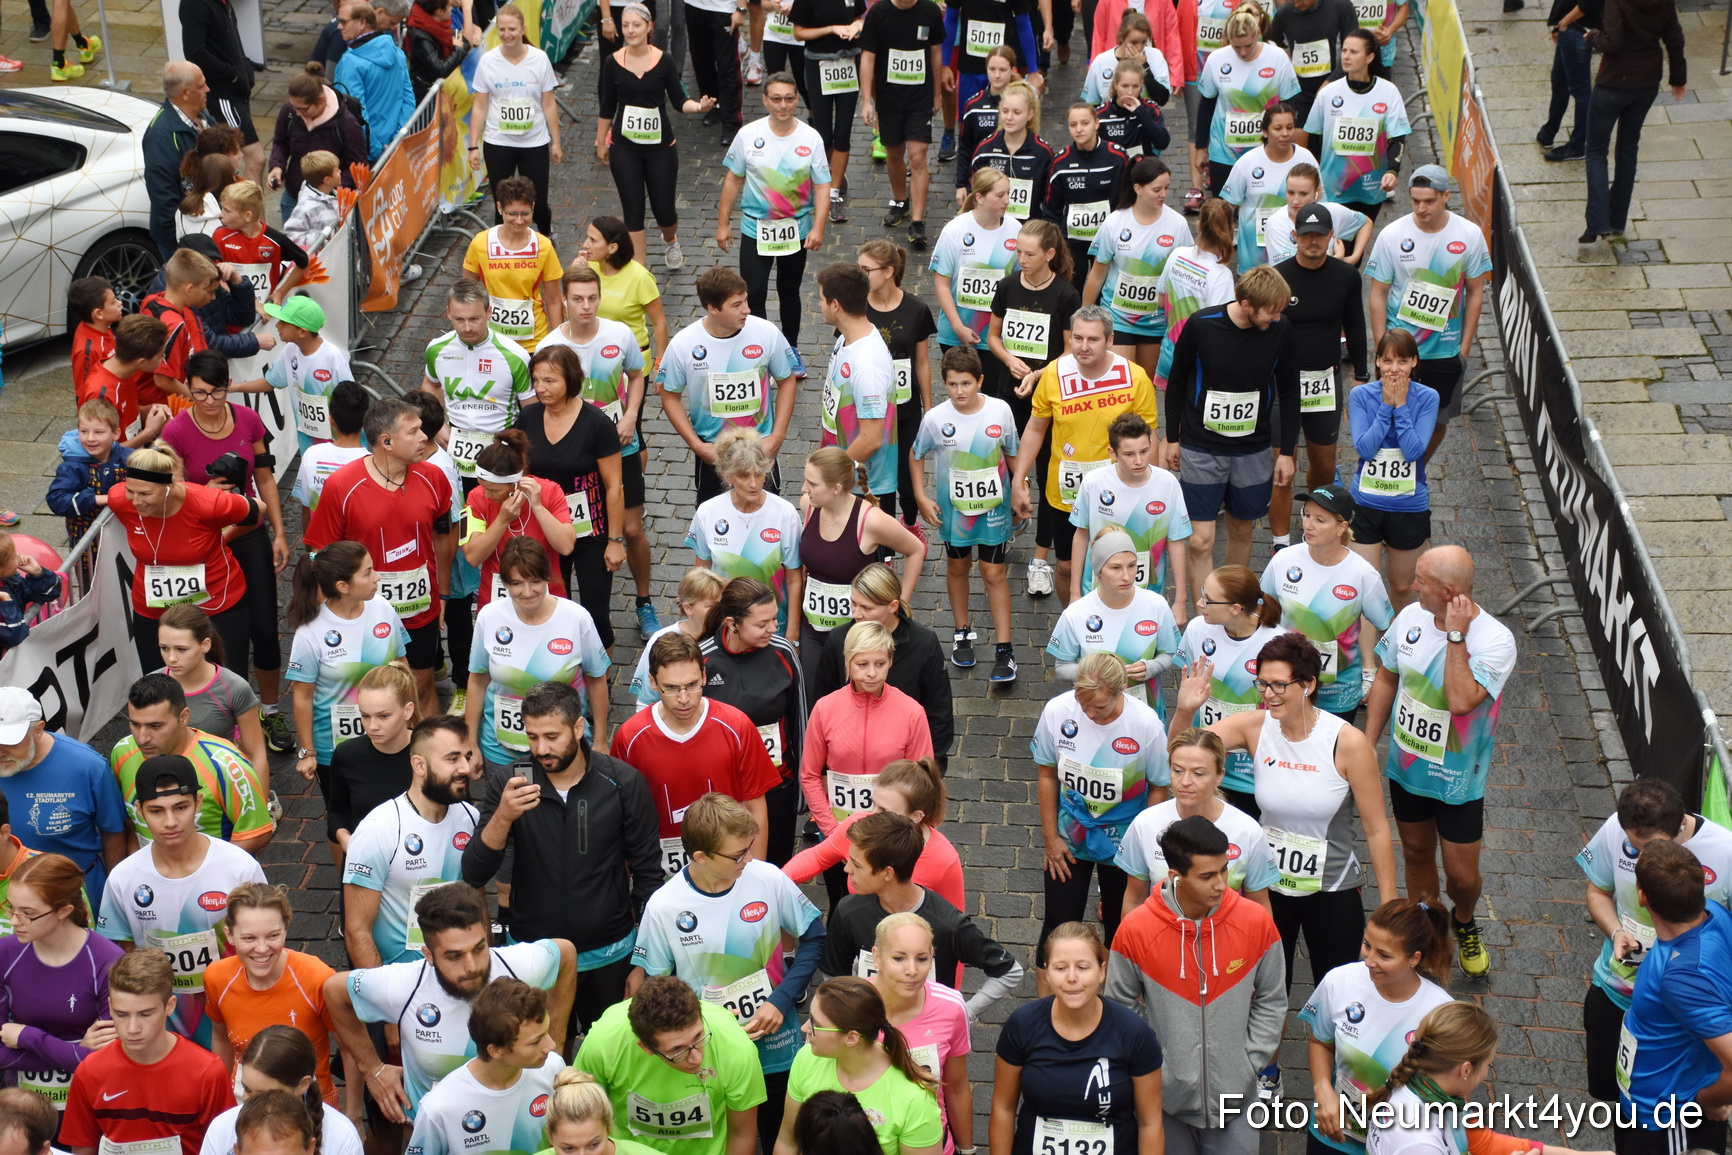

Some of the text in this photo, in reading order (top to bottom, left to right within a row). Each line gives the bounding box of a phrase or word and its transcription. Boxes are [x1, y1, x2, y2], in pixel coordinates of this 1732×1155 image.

[774, 13, 792, 26] 502
[970, 30, 1000, 44] 5010
[1200, 26, 1222, 40] 506
[1302, 50, 1318, 64] 55
[892, 58, 922, 72] 5019
[824, 66, 854, 82] 5082
[500, 107, 531, 120] 5007
[626, 116, 659, 130] 5160
[978, 120, 994, 128] Götz
[1230, 121, 1262, 134] 5009
[1338, 126, 1374, 141] 5083
[1010, 188, 1028, 204] 49
[1072, 212, 1106, 226] 5044
[762, 226, 796, 242] 5140
[1076, 228, 1098, 236] Christi
[488, 261, 538, 270] MAX BÖGL
[254, 274, 268, 290] 22
[962, 278, 999, 294] 5034
[1118, 282, 1156, 300] 5096
[961, 296, 993, 306] Anna-Cari
[1122, 302, 1148, 310] Johanna
[1408, 290, 1449, 315] 5097
[492, 308, 530, 325] 5252
[1410, 310, 1436, 324] Michael
[501, 327, 518, 336] Lydia
[1007, 321, 1044, 342] 5272
[1013, 342, 1034, 352] Leonie
[715, 381, 756, 400] 5231
[1302, 378, 1330, 396] 184
[462, 403, 498, 411] ENERGIE
[724, 404, 748, 412] Florian
[1061, 394, 1134, 416] MAX BÖGL
[1210, 403, 1254, 420] 5162
[299, 402, 326, 422] 4035
[1217, 423, 1244, 431] Thomas
[454, 440, 484, 460] 522
[456, 463, 476, 472] Reinh
[1367, 460, 1411, 478] 5183
[1064, 473, 1083, 488] 51
[955, 479, 998, 498] 5164
[968, 502, 984, 510] Luis
[1098, 506, 1114, 514] PARTL
[152, 578, 200, 598] 5129
[382, 578, 427, 601] 5128
[1283, 583, 1299, 593] PARTL
[1336, 587, 1354, 598] Hervis
[809, 592, 851, 616] 5193
[820, 618, 836, 627] Vera
[1137, 624, 1156, 632] Hervis
[327, 648, 346, 656] PARTL
[493, 646, 512, 654] PARTL
[551, 642, 572, 651] Hervis
[500, 710, 525, 732] 53
[1204, 706, 1222, 726] 51
[339, 718, 364, 736] 50
[1398, 704, 1442, 742] 5186
[1058, 738, 1076, 749] PARTL
[1116, 741, 1136, 751] Hervis
[1400, 733, 1428, 753] Michael
[1235, 752, 1250, 761] 17.
[1278, 762, 1320, 772] KLEBL
[211, 748, 256, 816] BOCK
[1064, 772, 1116, 801] 5005
[835, 786, 874, 809] 513
[405, 858, 427, 867] PARTL
[1269, 844, 1318, 876] 104
[1619, 858, 1636, 868] PART
[1280, 878, 1297, 888] etra
[202, 896, 227, 907] Hervis
[135, 910, 156, 918] PARTL
[743, 906, 766, 918] Hervis
[168, 934, 209, 948] BOCK
[680, 934, 703, 944] PARTL
[169, 947, 212, 973] 204
[1229, 958, 1244, 968] NIKE
[727, 974, 762, 995] BOCK
[416, 1028, 442, 1038] PARTL
[1342, 1022, 1359, 1035] PARTL
[416, 1036, 442, 1044] Neumarkt
[766, 1038, 795, 1051] Stadtlauf
[36, 1089, 68, 1101] Natali
[636, 1105, 704, 1126] 5194
[658, 1128, 682, 1136] Alex
[1068, 1122, 1106, 1135] BOCK
[128, 1140, 173, 1151] BOCK
[464, 1134, 490, 1145] PARTL
[464, 1140, 491, 1149] Neumarkt
[1042, 1136, 1107, 1155] 5132
